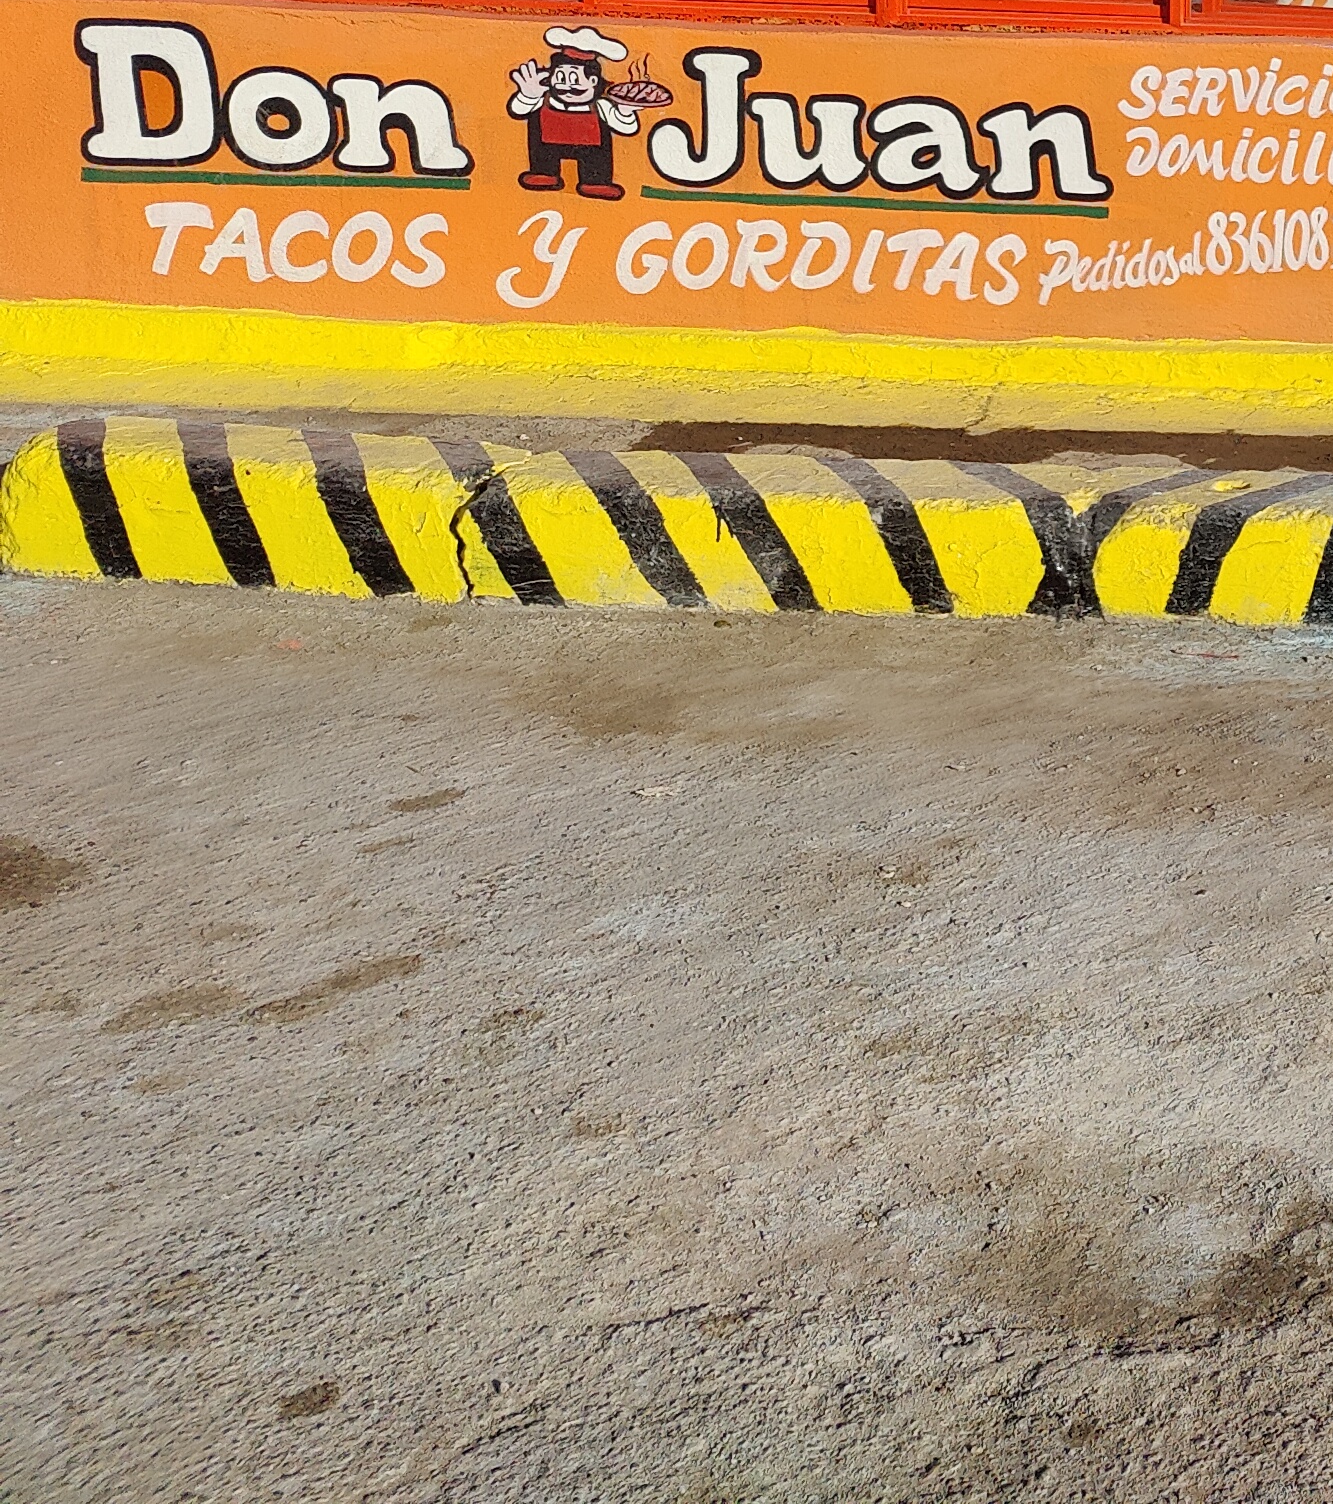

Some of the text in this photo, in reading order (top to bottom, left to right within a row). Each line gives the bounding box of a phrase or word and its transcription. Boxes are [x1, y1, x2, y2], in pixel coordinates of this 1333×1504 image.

[74, 19, 1115, 201] Don Juan
[144, 201, 449, 288] TACOS
[616, 218, 1028, 307] GORDITAS
